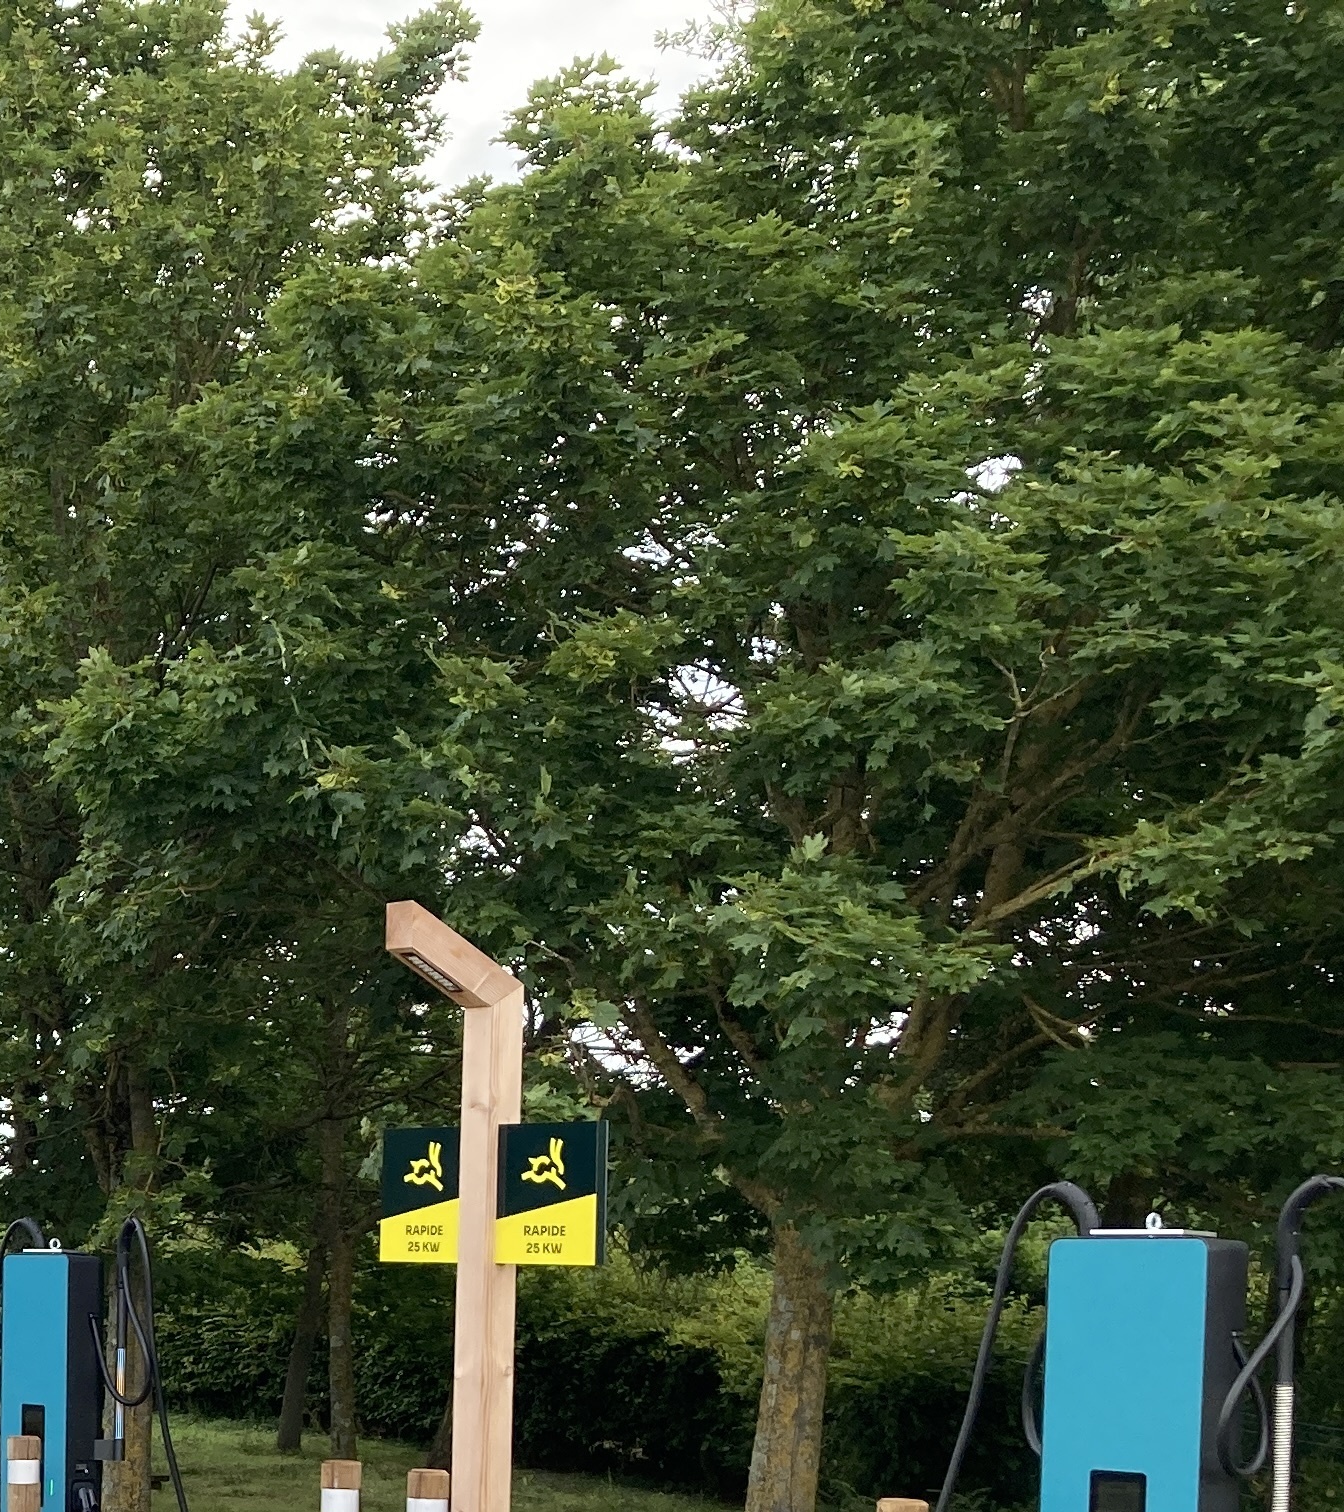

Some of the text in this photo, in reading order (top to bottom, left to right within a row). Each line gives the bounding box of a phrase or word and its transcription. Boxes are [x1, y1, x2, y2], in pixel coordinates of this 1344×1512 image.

[405, 1225, 444, 1237] RAPIDE
[523, 1225, 566, 1237] RAPIDE
[407, 1241, 441, 1253] 25 KW
[526, 1243, 563, 1254] 25 KW
